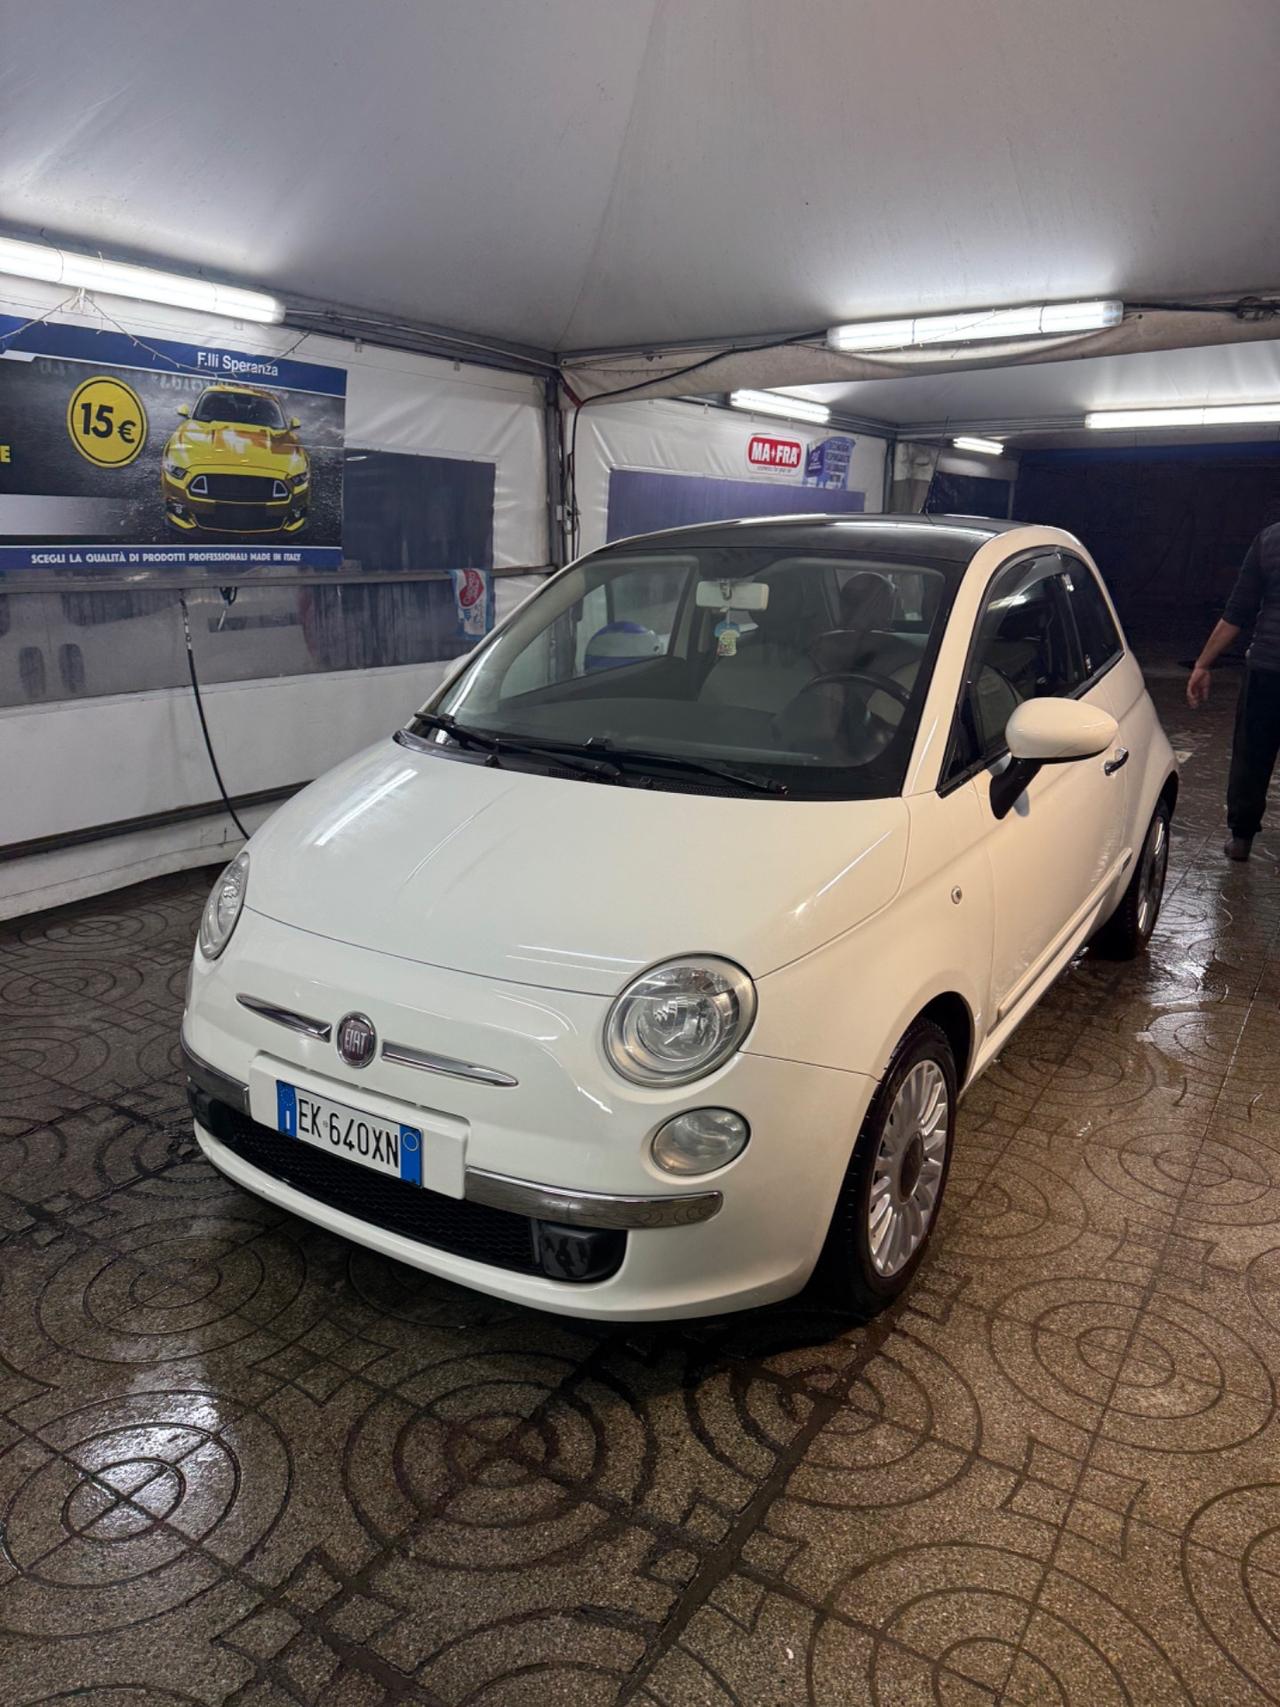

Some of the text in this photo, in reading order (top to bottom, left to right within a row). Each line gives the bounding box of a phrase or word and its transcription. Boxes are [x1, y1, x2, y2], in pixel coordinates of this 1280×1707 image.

[197, 351, 279, 377] F.lli Speranza
[31, 551, 301, 564] SCEGLI LA QUALITÀ DI PRODOTTI PROFESSIONALI MADE IN ITALY
[344, 1028, 367, 1055] FIAT
